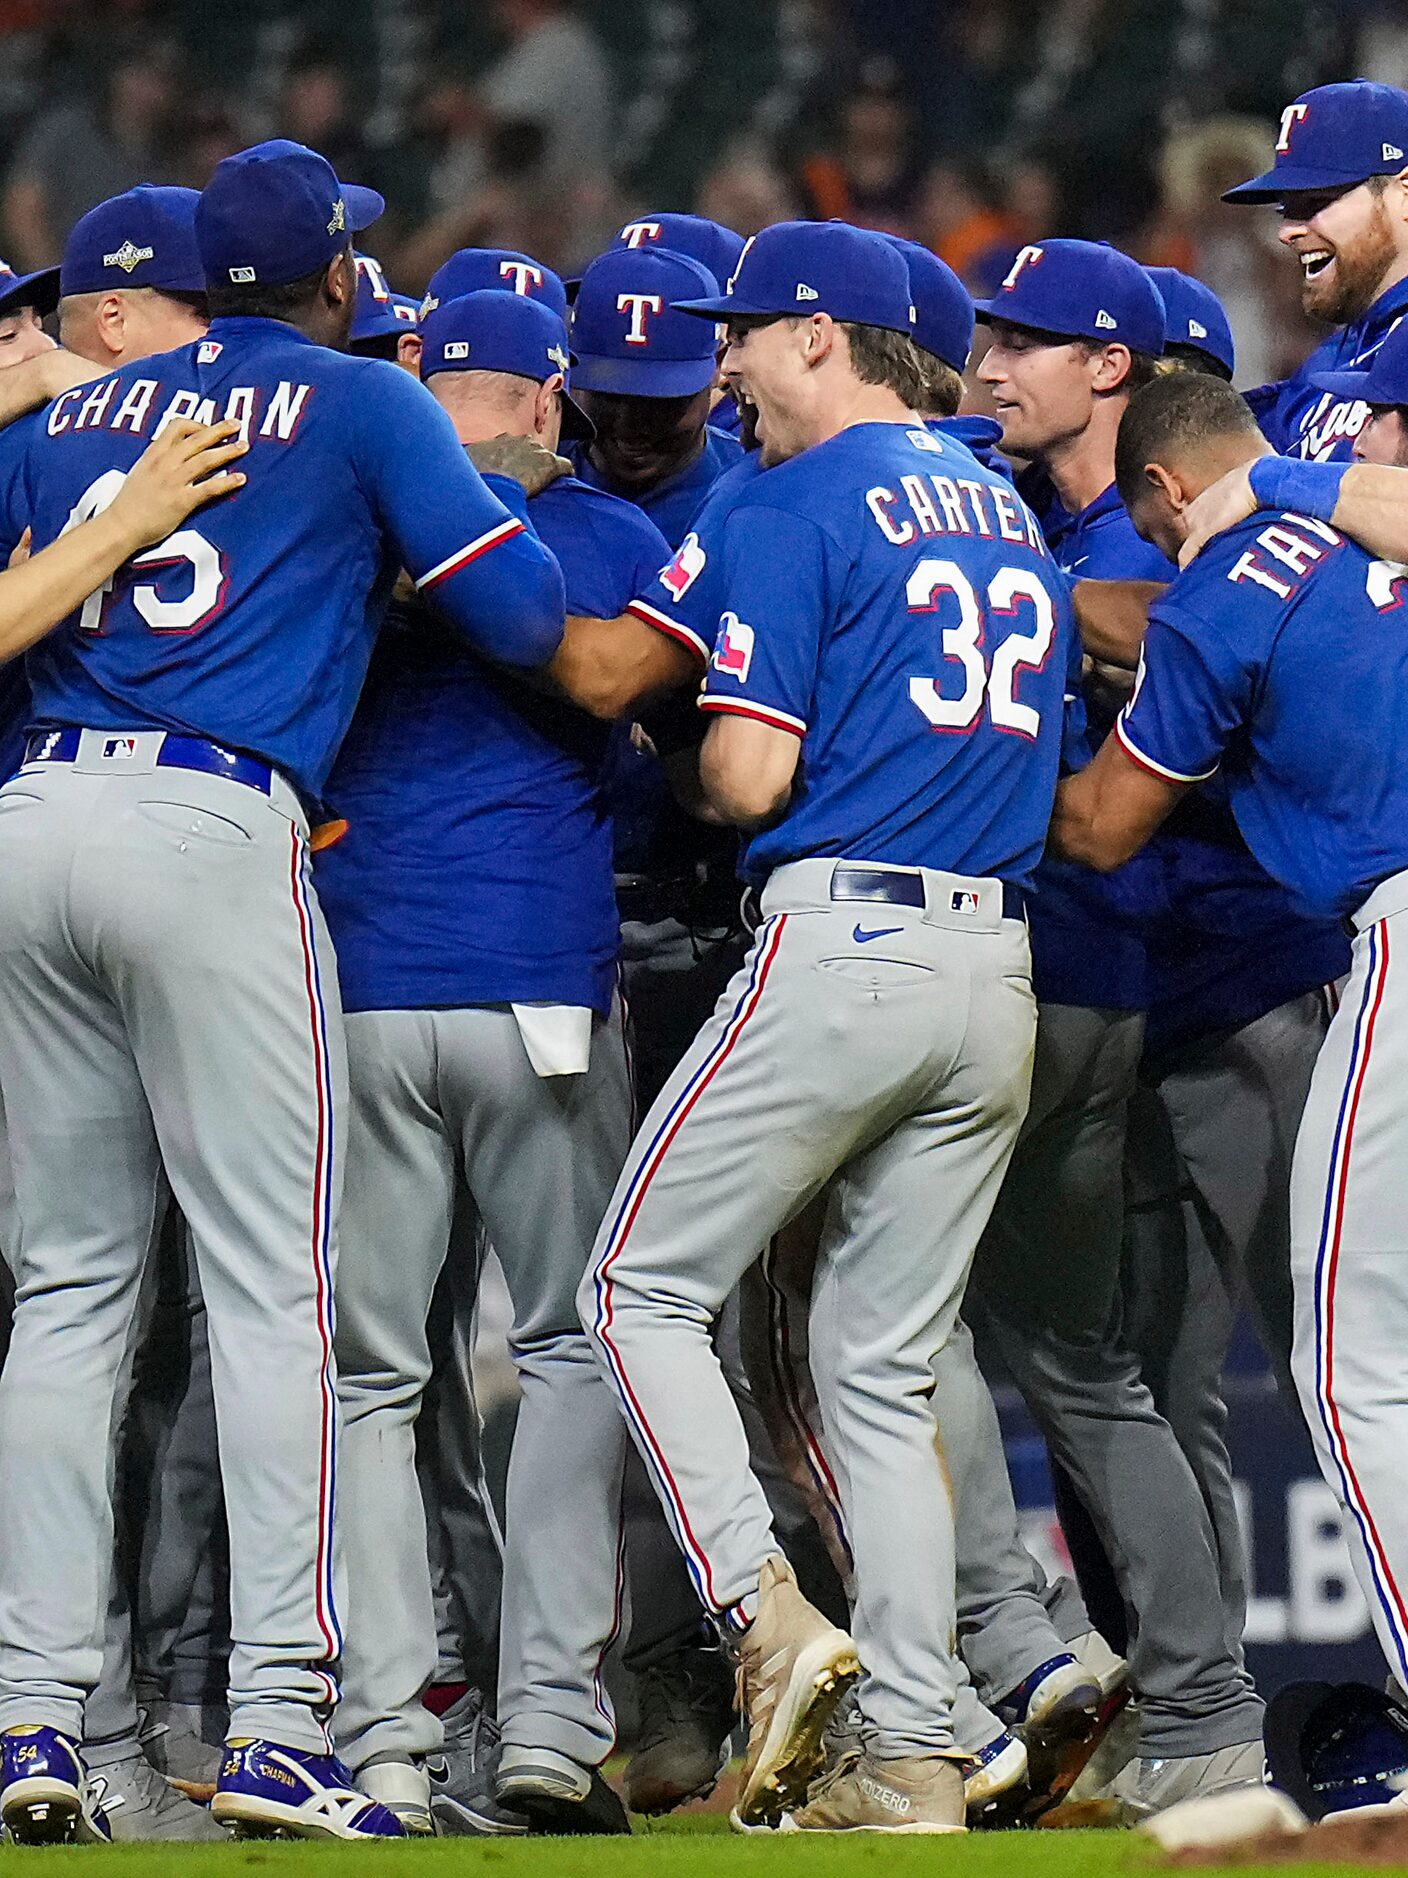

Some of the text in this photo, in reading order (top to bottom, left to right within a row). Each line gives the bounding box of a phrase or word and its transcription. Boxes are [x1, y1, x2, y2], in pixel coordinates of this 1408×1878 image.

[617, 294, 662, 344] T
[906, 559, 1055, 739] 32
[18, 1745, 37, 1763] 54
[261, 1764, 296, 1788] CHAPMAN
